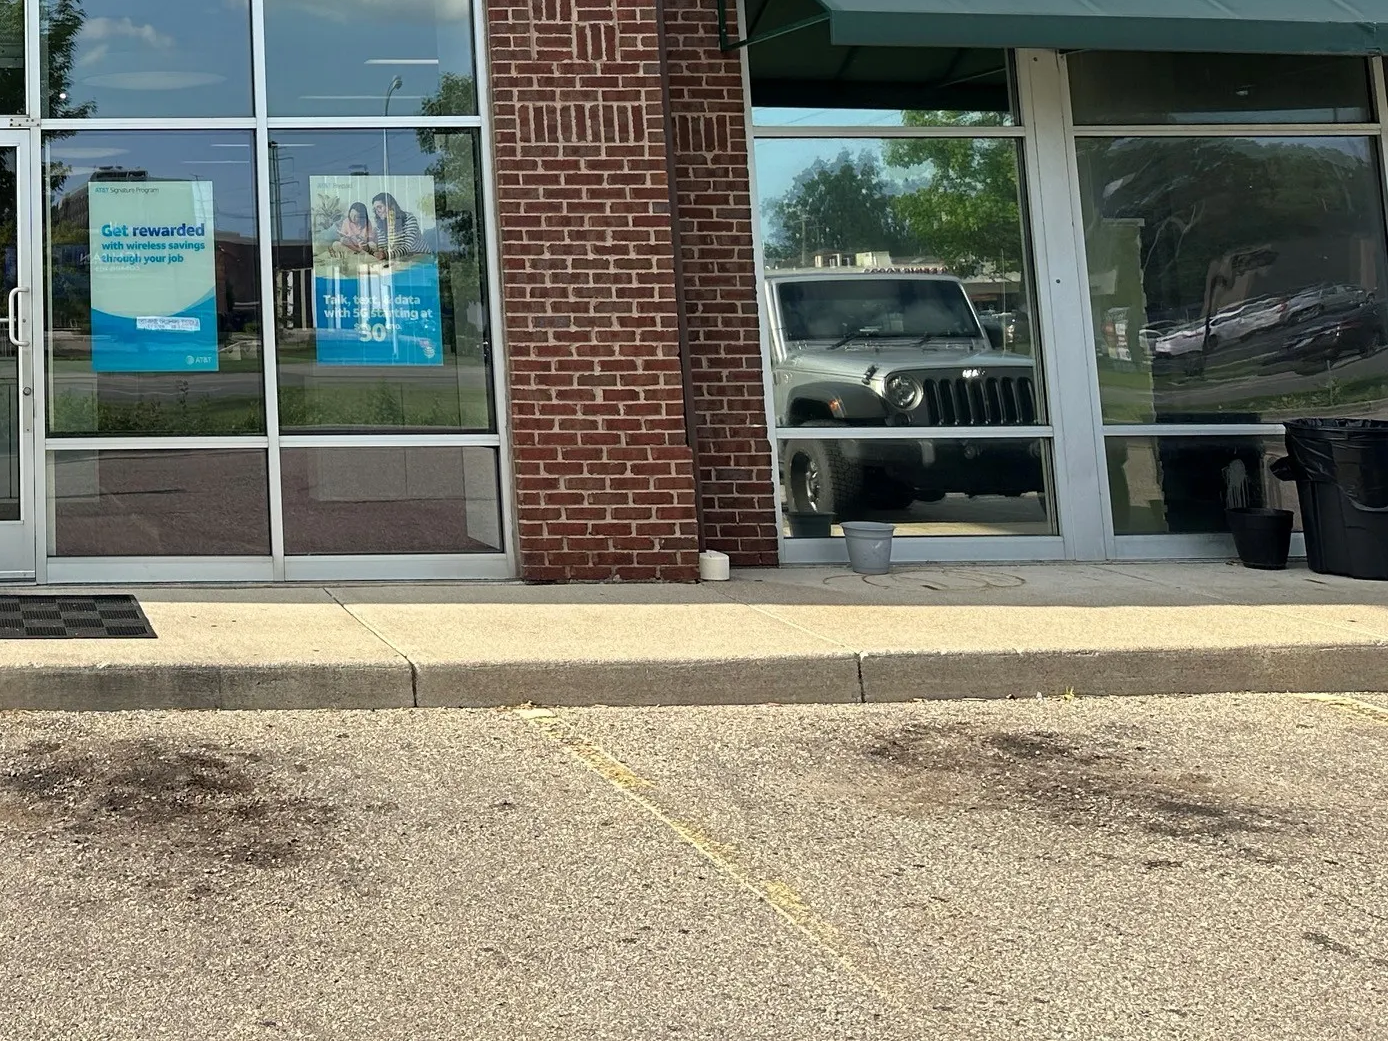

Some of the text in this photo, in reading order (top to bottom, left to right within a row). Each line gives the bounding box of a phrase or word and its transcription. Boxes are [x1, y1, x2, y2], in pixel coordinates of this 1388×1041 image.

[136, 186, 159, 194] Program
[101, 223, 205, 237] Get rewarded
[101, 240, 206, 251] with wireless savings
[101, 253, 184, 265] through your job
[323, 294, 351, 306] Talk,
[394, 294, 421, 305] data
[324, 308, 351, 318] with
[420, 309, 433, 318] at
